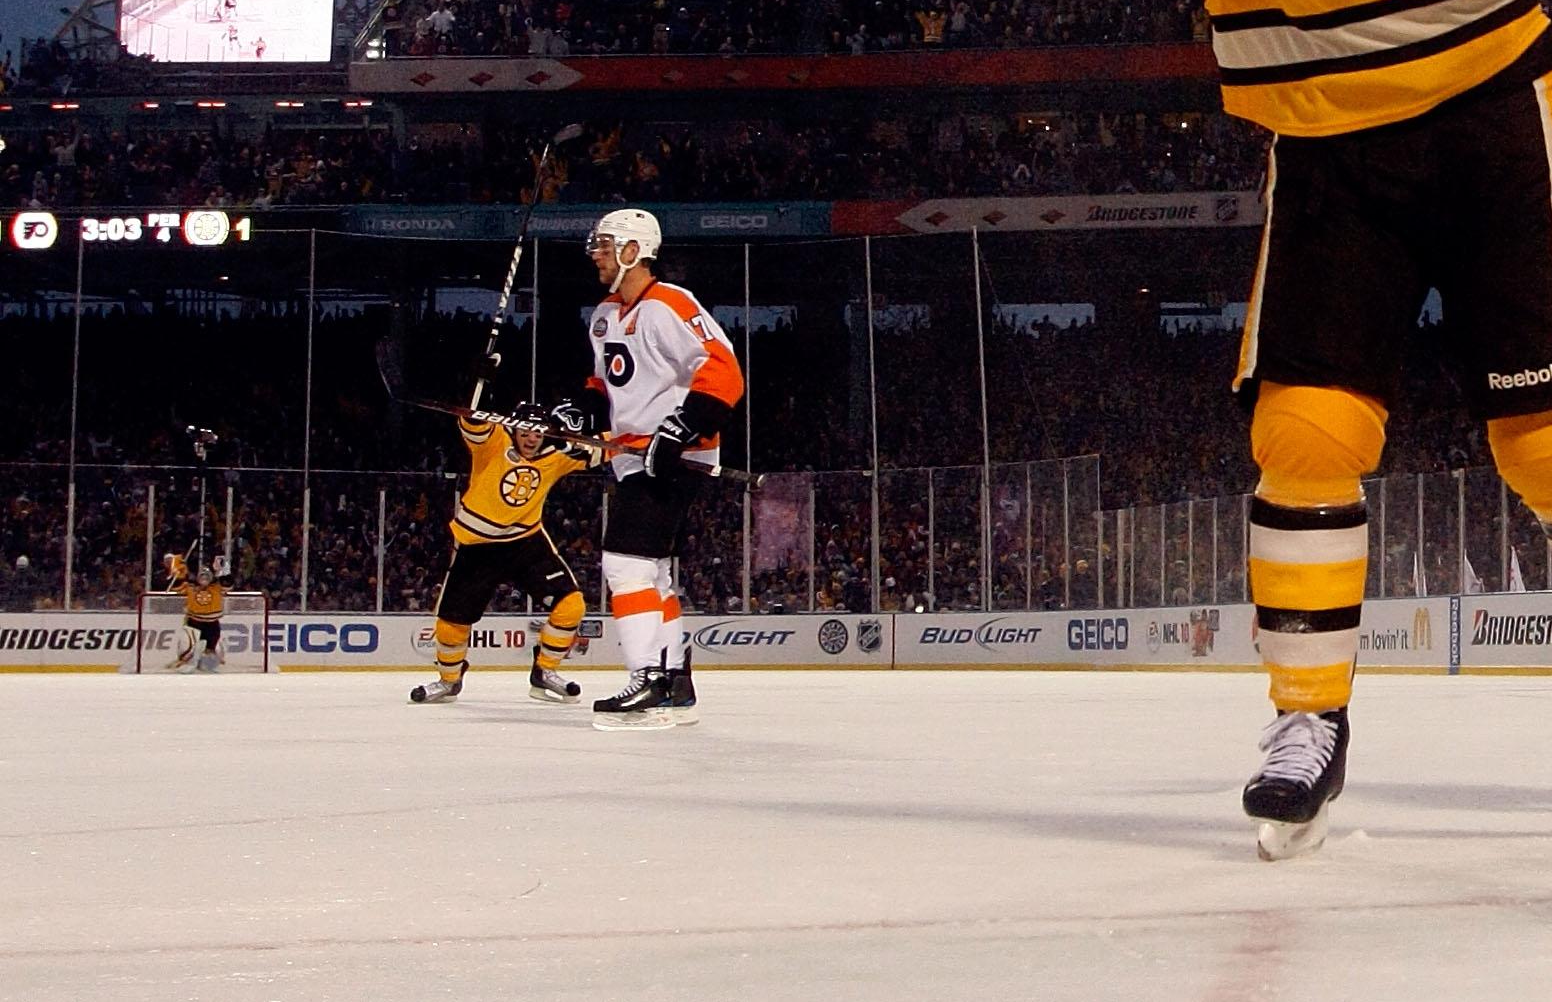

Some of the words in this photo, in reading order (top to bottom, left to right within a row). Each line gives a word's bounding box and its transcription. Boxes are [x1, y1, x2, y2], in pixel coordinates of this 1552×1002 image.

[81, 217, 142, 241] 3:03
[235, 217, 251, 241] 1
[381, 219, 456, 231] HONDA
[700, 214, 769, 229] GEICO
[0, 629, 174, 650] RIDGESTONE
[504, 630, 526, 647] 10
[706, 630, 796, 646] LIGHT
[920, 628, 972, 644] BUD
[984, 627, 1042, 644] LIGHT
[1068, 617, 1128, 650] GEICO
[1372, 630, 1399, 650] lovin'
[1401, 630, 1408, 650] it
